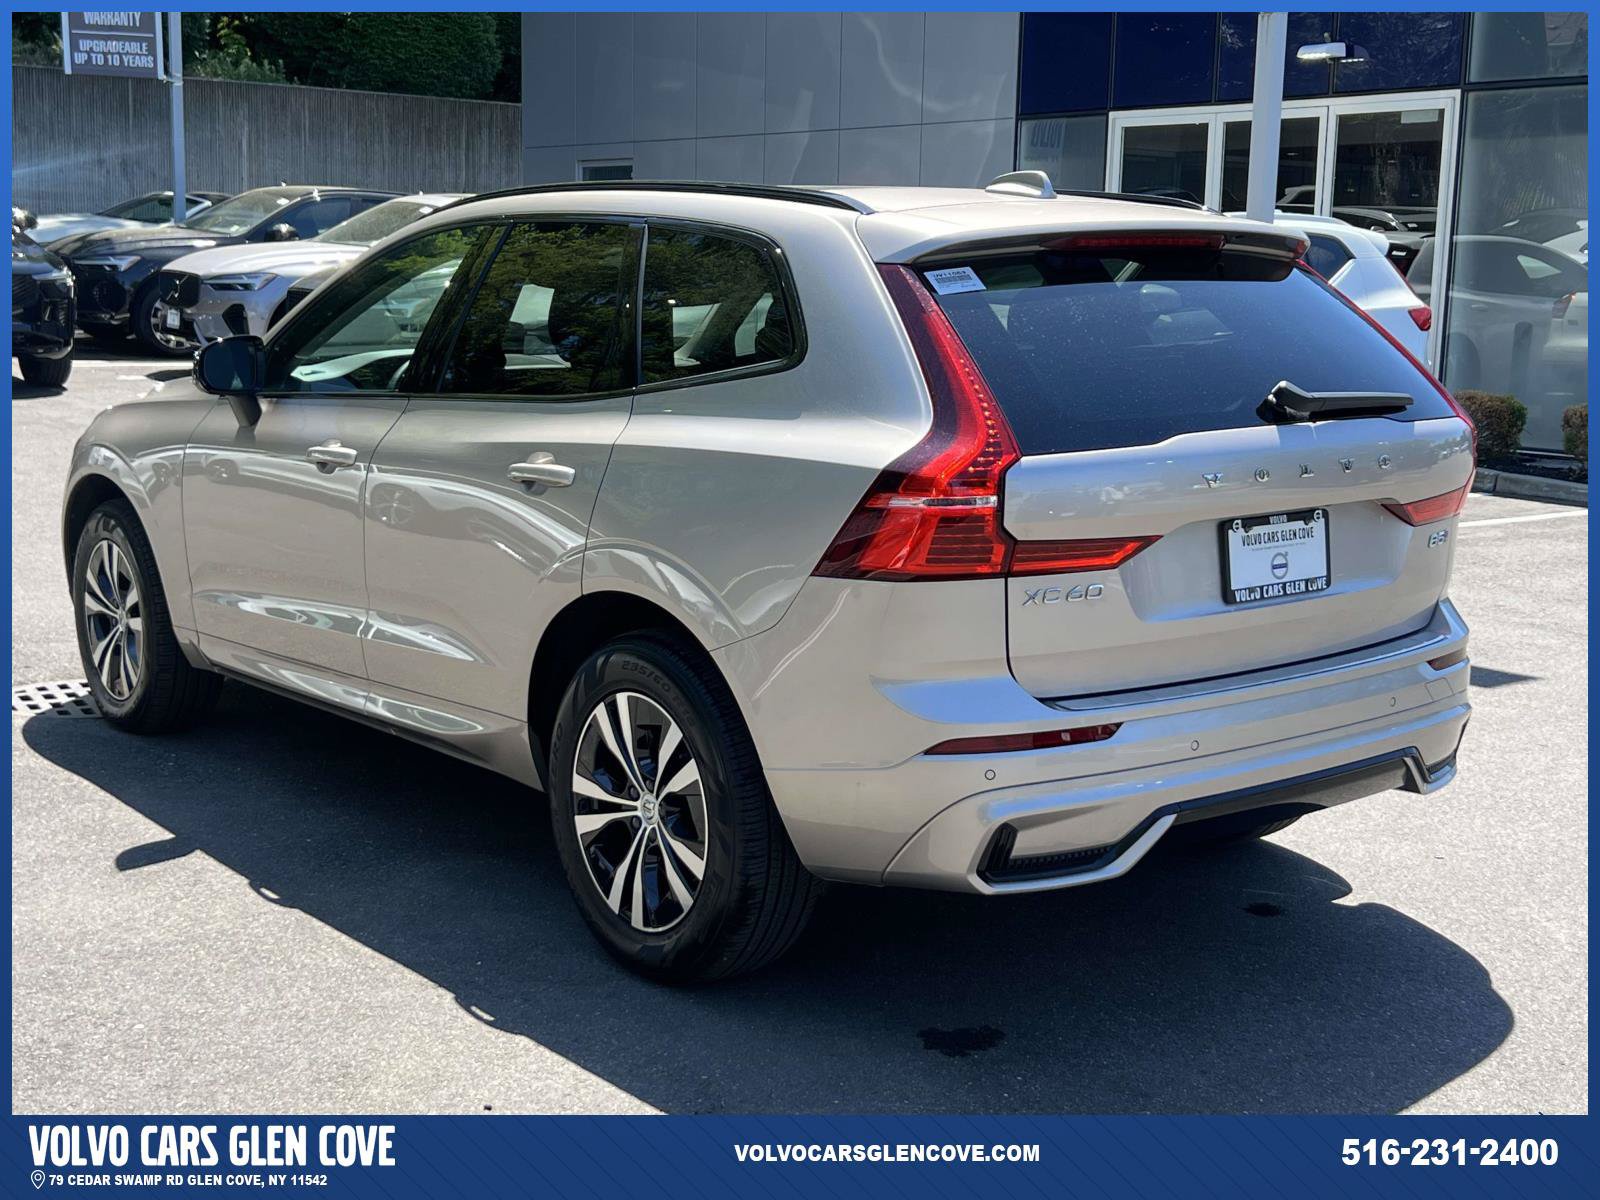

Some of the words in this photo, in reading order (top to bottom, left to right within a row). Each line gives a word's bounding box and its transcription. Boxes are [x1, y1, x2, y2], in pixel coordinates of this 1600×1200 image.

[79, 39, 149, 55] UPGRADEABLE
[74, 52, 88, 65] UP
[91, 53, 104, 66] TO
[107, 54, 120, 67] 10
[123, 55, 154, 68] YEARS
[1202, 454, 1393, 489] VOLVO
[1241, 531, 1261, 547] VOLVO
[1263, 530, 1279, 544] CARS
[1281, 528, 1297, 542] GLEN
[1298, 526, 1315, 540] COVE
[1263, 583, 1284, 598] CARS
[1286, 580, 1306, 595] GLEN
